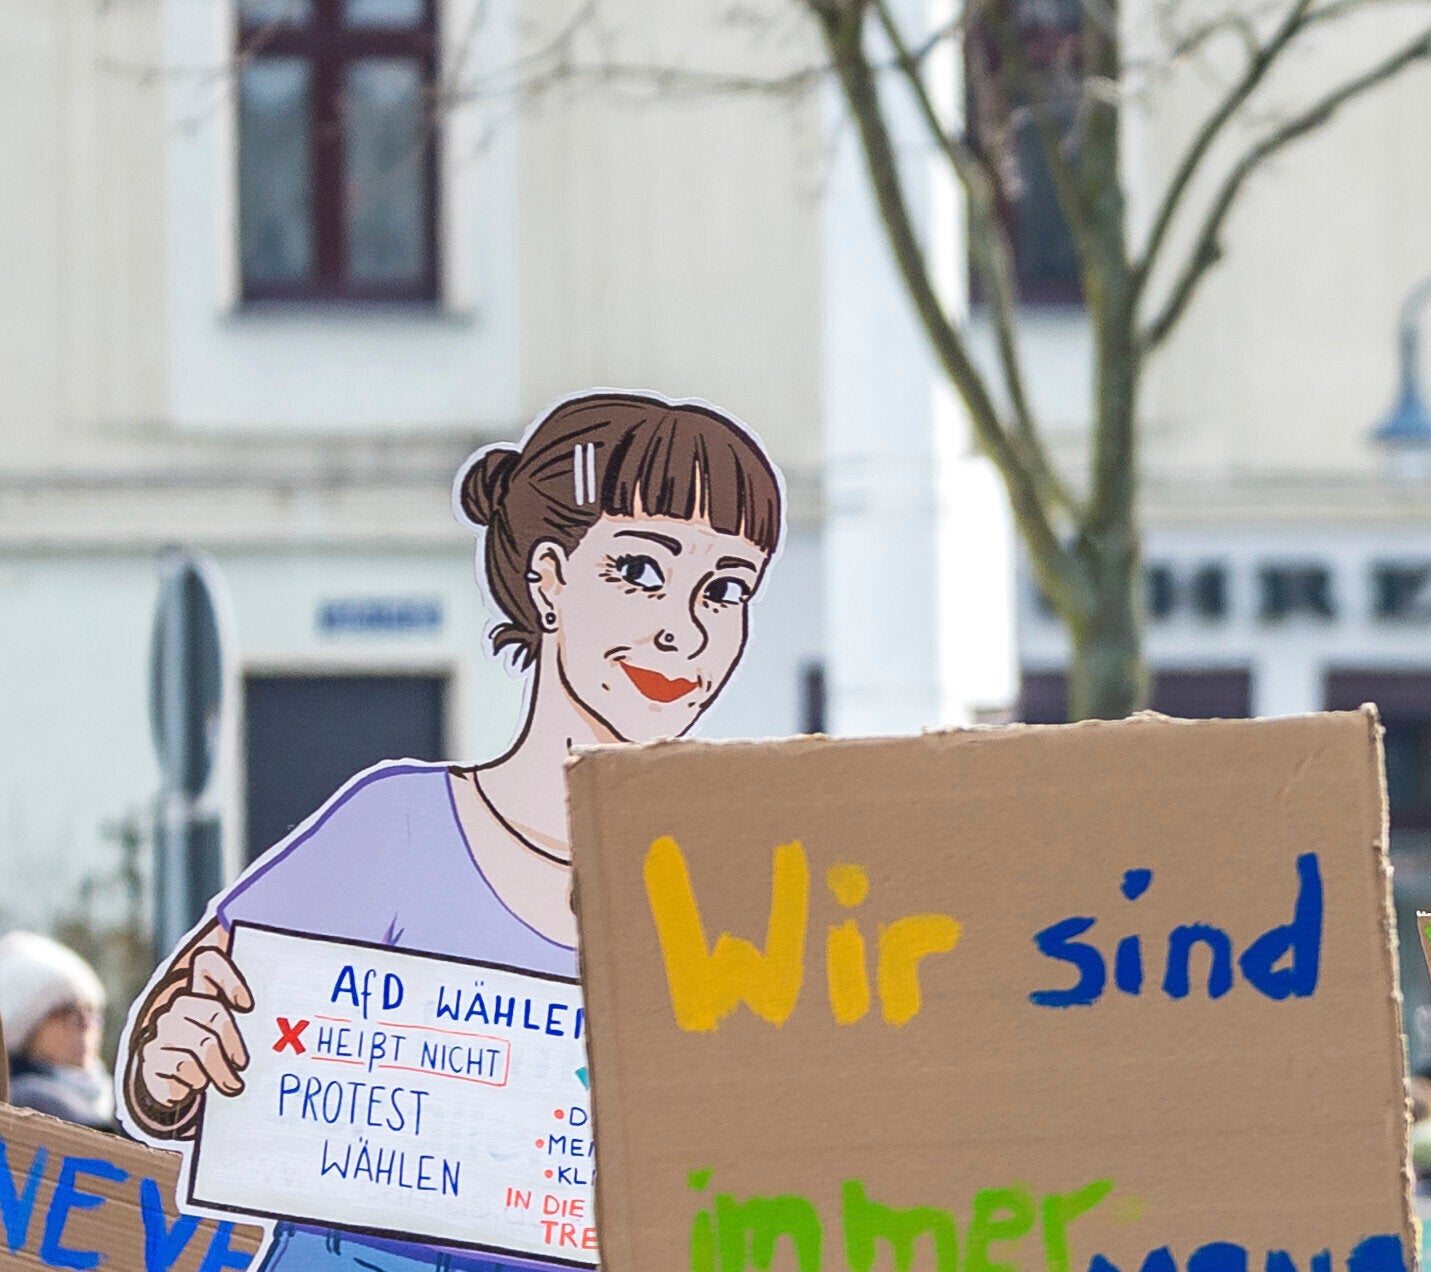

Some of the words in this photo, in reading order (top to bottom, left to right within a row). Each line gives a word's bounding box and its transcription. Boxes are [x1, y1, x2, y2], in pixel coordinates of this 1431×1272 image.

[643, 836, 963, 1032] Wir
[1029, 851, 1325, 1009] sind
[331, 965, 404, 1019] AfD
[421, 1041, 500, 1078] NICHT
[279, 1073, 429, 1135] PROTEST
[569, 1106, 588, 1127] D
[321, 1136, 460, 1197] WÄHLEN
[506, 1187, 532, 1210] IN
[543, 1194, 586, 1218] DIE
[540, 1220, 597, 1251] TRE
